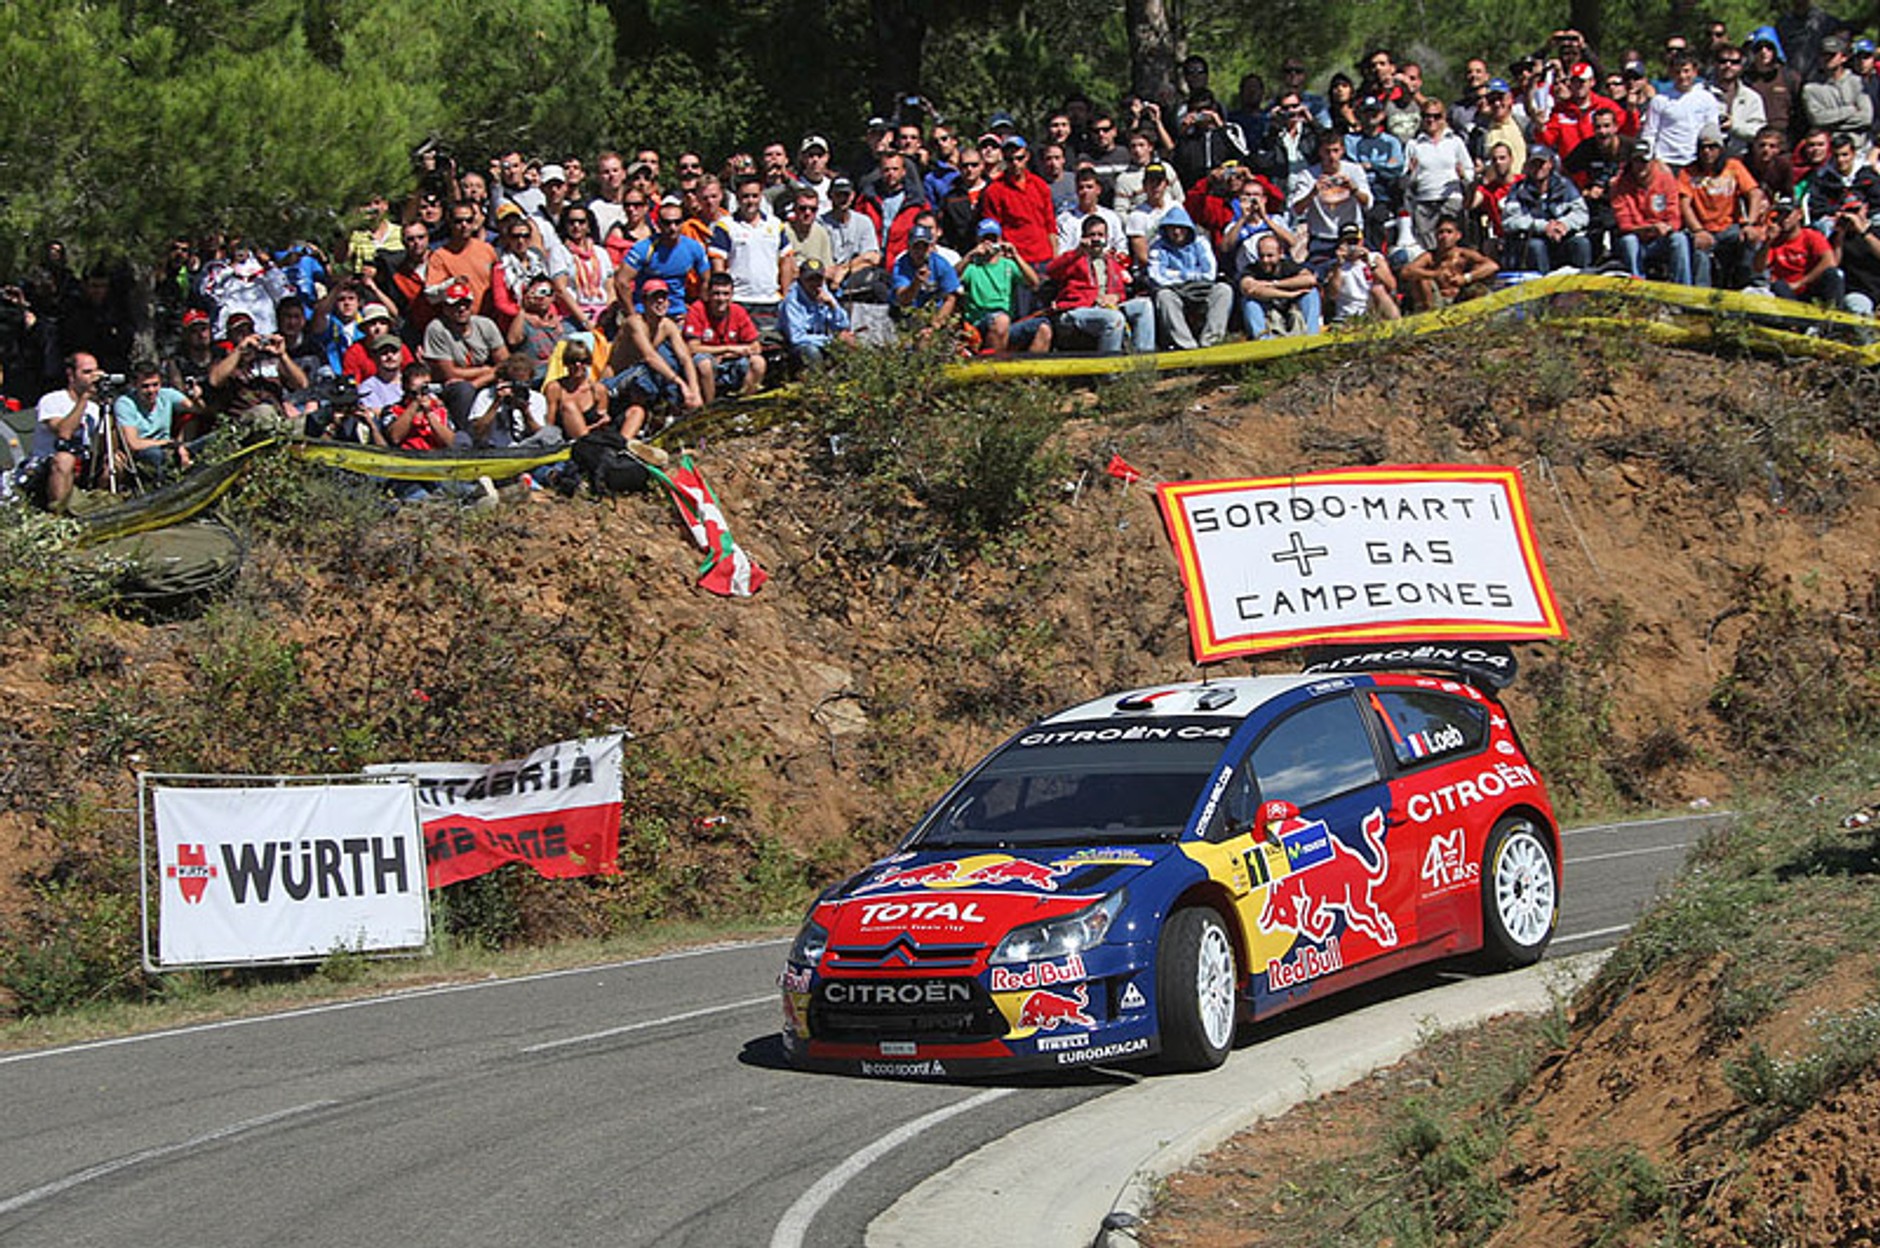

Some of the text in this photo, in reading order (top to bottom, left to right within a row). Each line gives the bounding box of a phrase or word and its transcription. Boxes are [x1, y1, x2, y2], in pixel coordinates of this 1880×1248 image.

[1365, 540, 1454, 566] GAS
[1236, 582, 1513, 621] CAMPEONES
[1461, 650, 1509, 668] C4
[1176, 726, 1232, 739] C4
[1422, 724, 1464, 753] Loeb
[1407, 762, 1538, 823] CITROËN
[219, 836, 409, 904] WÜRTH
[1248, 850, 1263, 884] 1
[860, 902, 986, 925] TOTAL
[992, 955, 1087, 991] Red Bull
[1267, 936, 1343, 992] Red Bull
[824, 981, 971, 1003] CITROËN
